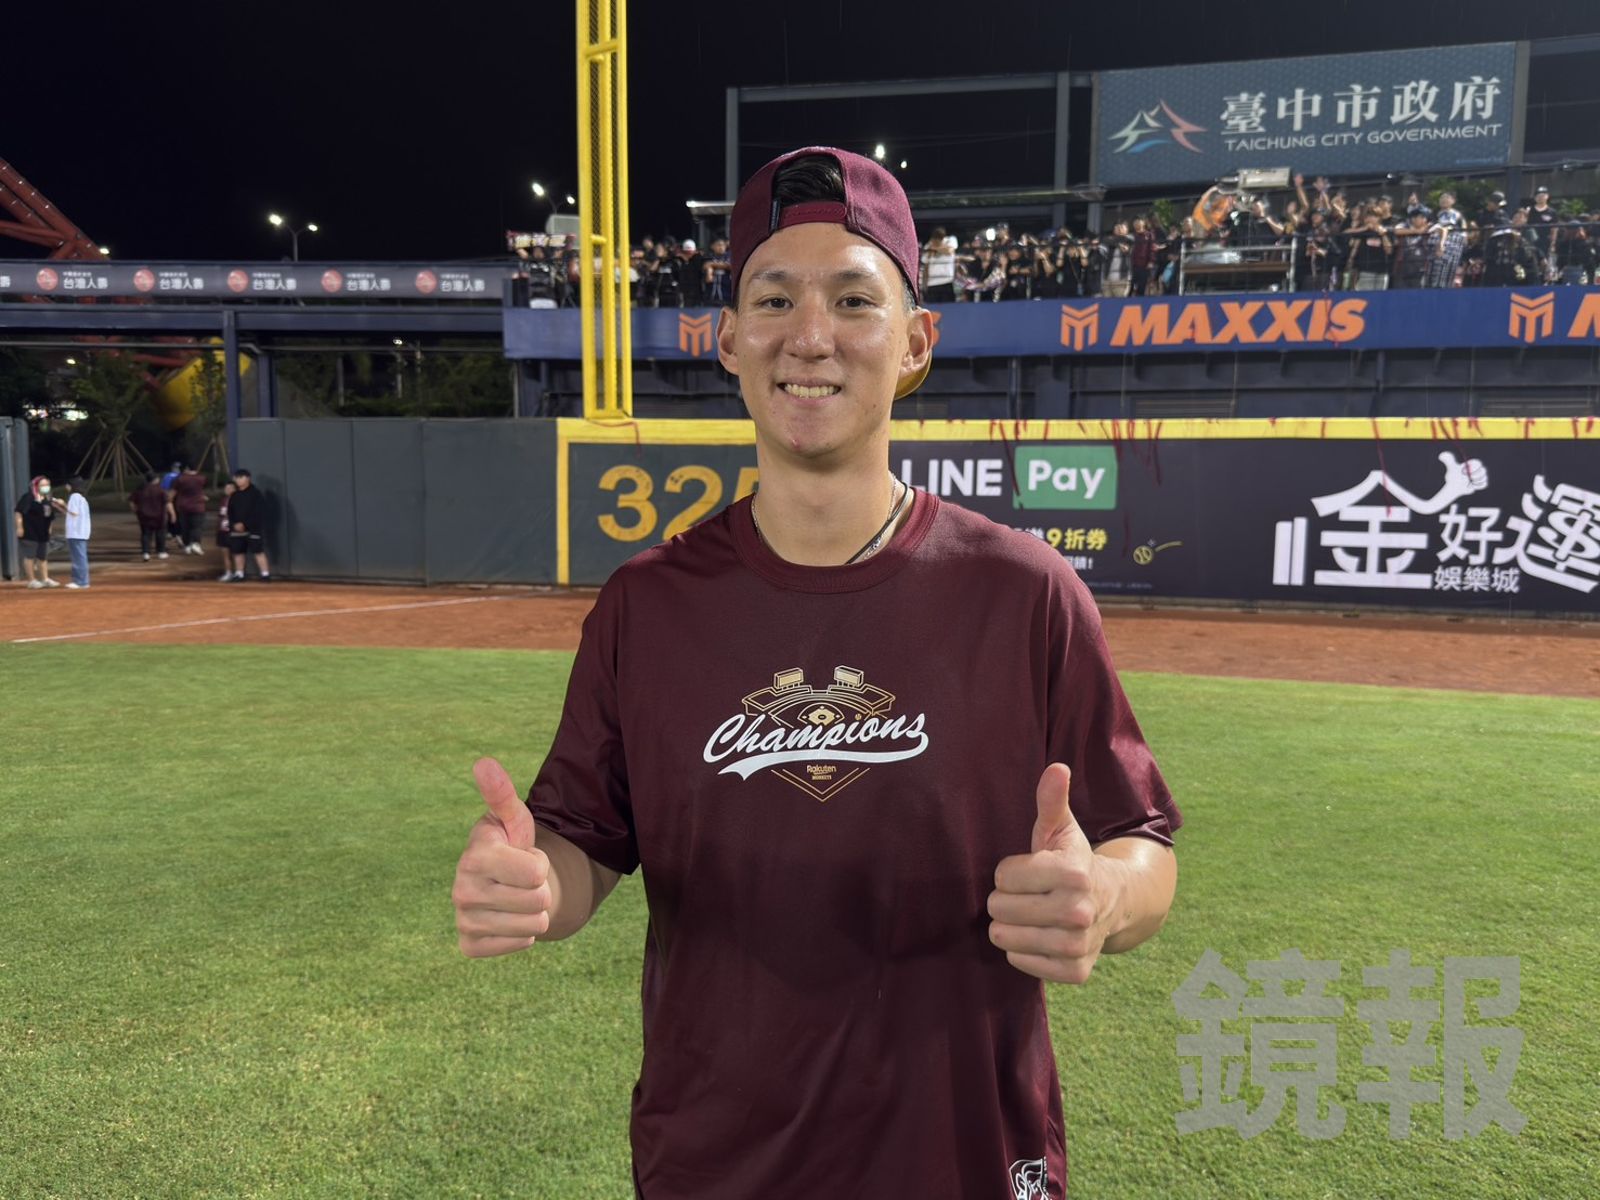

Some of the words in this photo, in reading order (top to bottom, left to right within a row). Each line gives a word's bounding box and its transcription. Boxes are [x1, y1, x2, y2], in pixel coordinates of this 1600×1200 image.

[1219, 75, 1501, 136] 臺中市政府
[1225, 133, 1317, 151] TAICHUNG
[1320, 131, 1362, 147] CITY
[1367, 123, 1502, 144] GOVERNMENT
[1109, 298, 1368, 347] MAXXIS
[901, 459, 1003, 496] LINE
[1028, 459, 1105, 499] Pay
[597, 464, 758, 542] 32
[1433, 565, 1521, 593] 娛樂城
[703, 712, 929, 780] Champions
[806, 764, 837, 774] Rakuten
